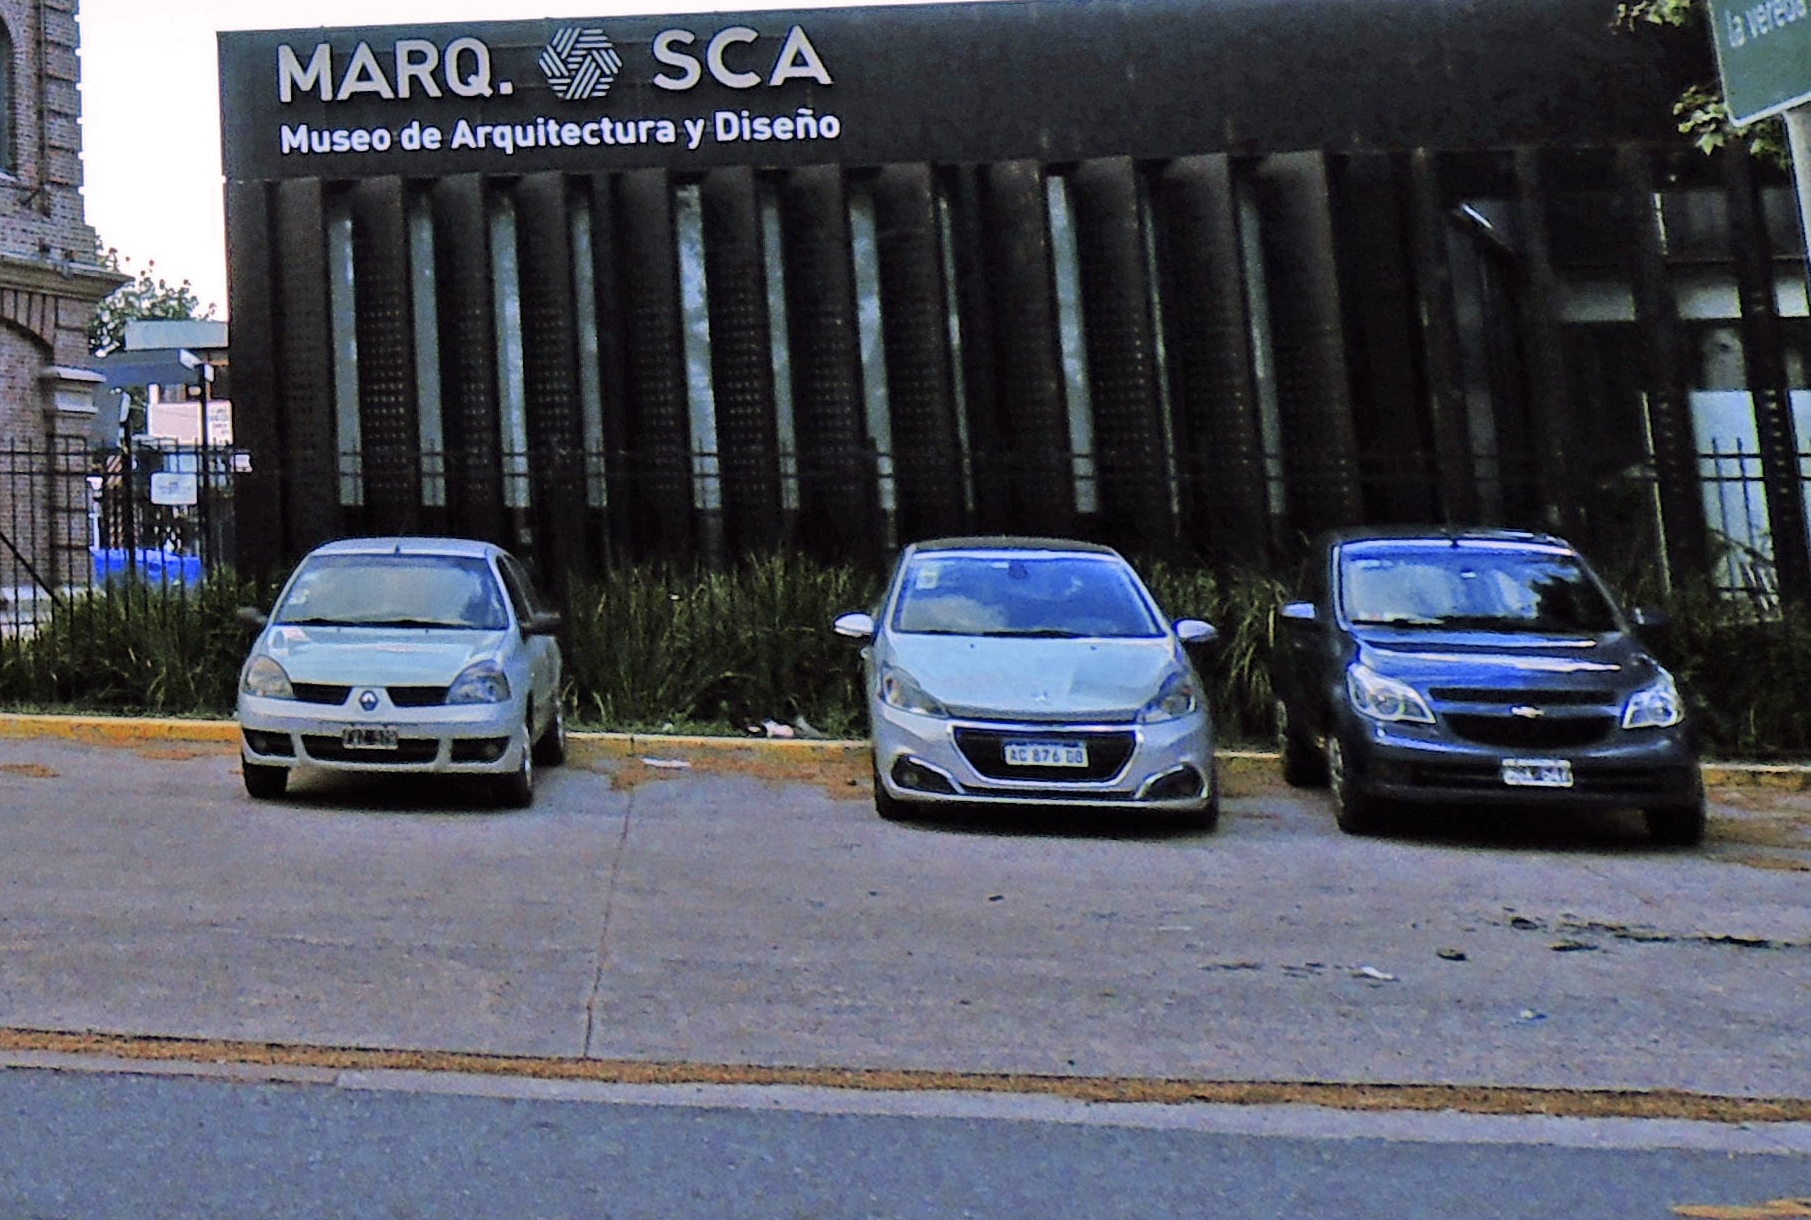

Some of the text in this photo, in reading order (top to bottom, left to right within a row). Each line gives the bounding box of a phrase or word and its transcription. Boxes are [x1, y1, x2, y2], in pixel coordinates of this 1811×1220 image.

[1724, 9, 1746, 48] la
[277, 25, 835, 103] MARQ. SCA
[281, 107, 840, 156] Museo de Arquitectura y Diseño
[1033, 749, 1060, 763] 876
